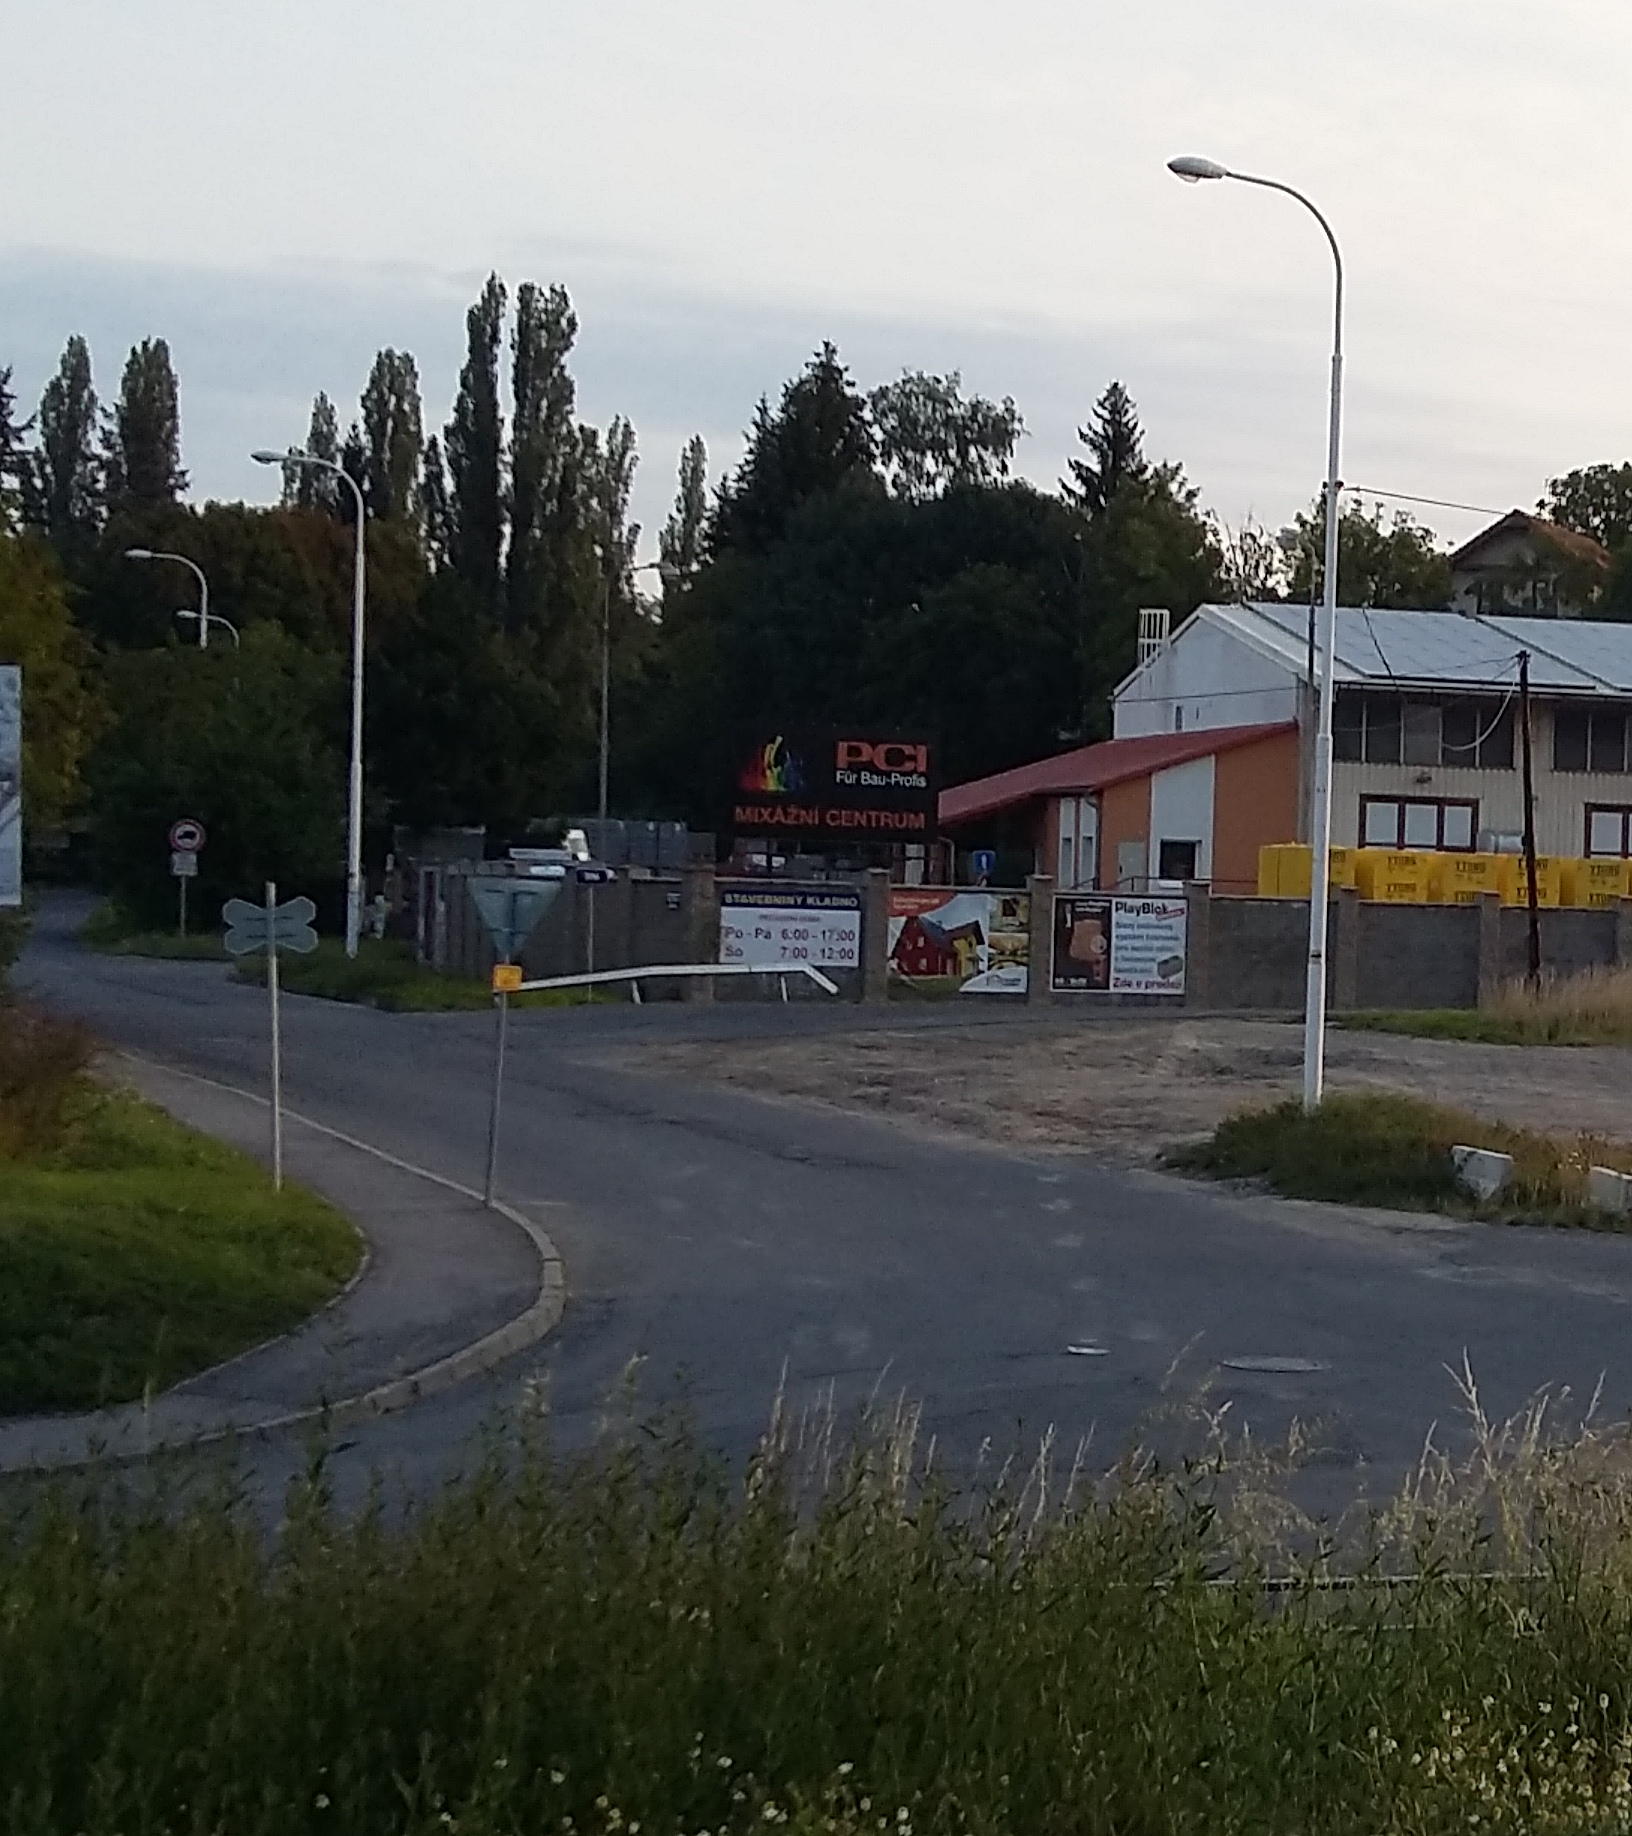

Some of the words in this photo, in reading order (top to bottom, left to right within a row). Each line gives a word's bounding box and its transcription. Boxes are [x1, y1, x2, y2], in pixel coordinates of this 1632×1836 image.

[836, 741, 928, 773] PCI
[826, 810, 926, 829] CENTRUM
[725, 926, 743, 939] Po
